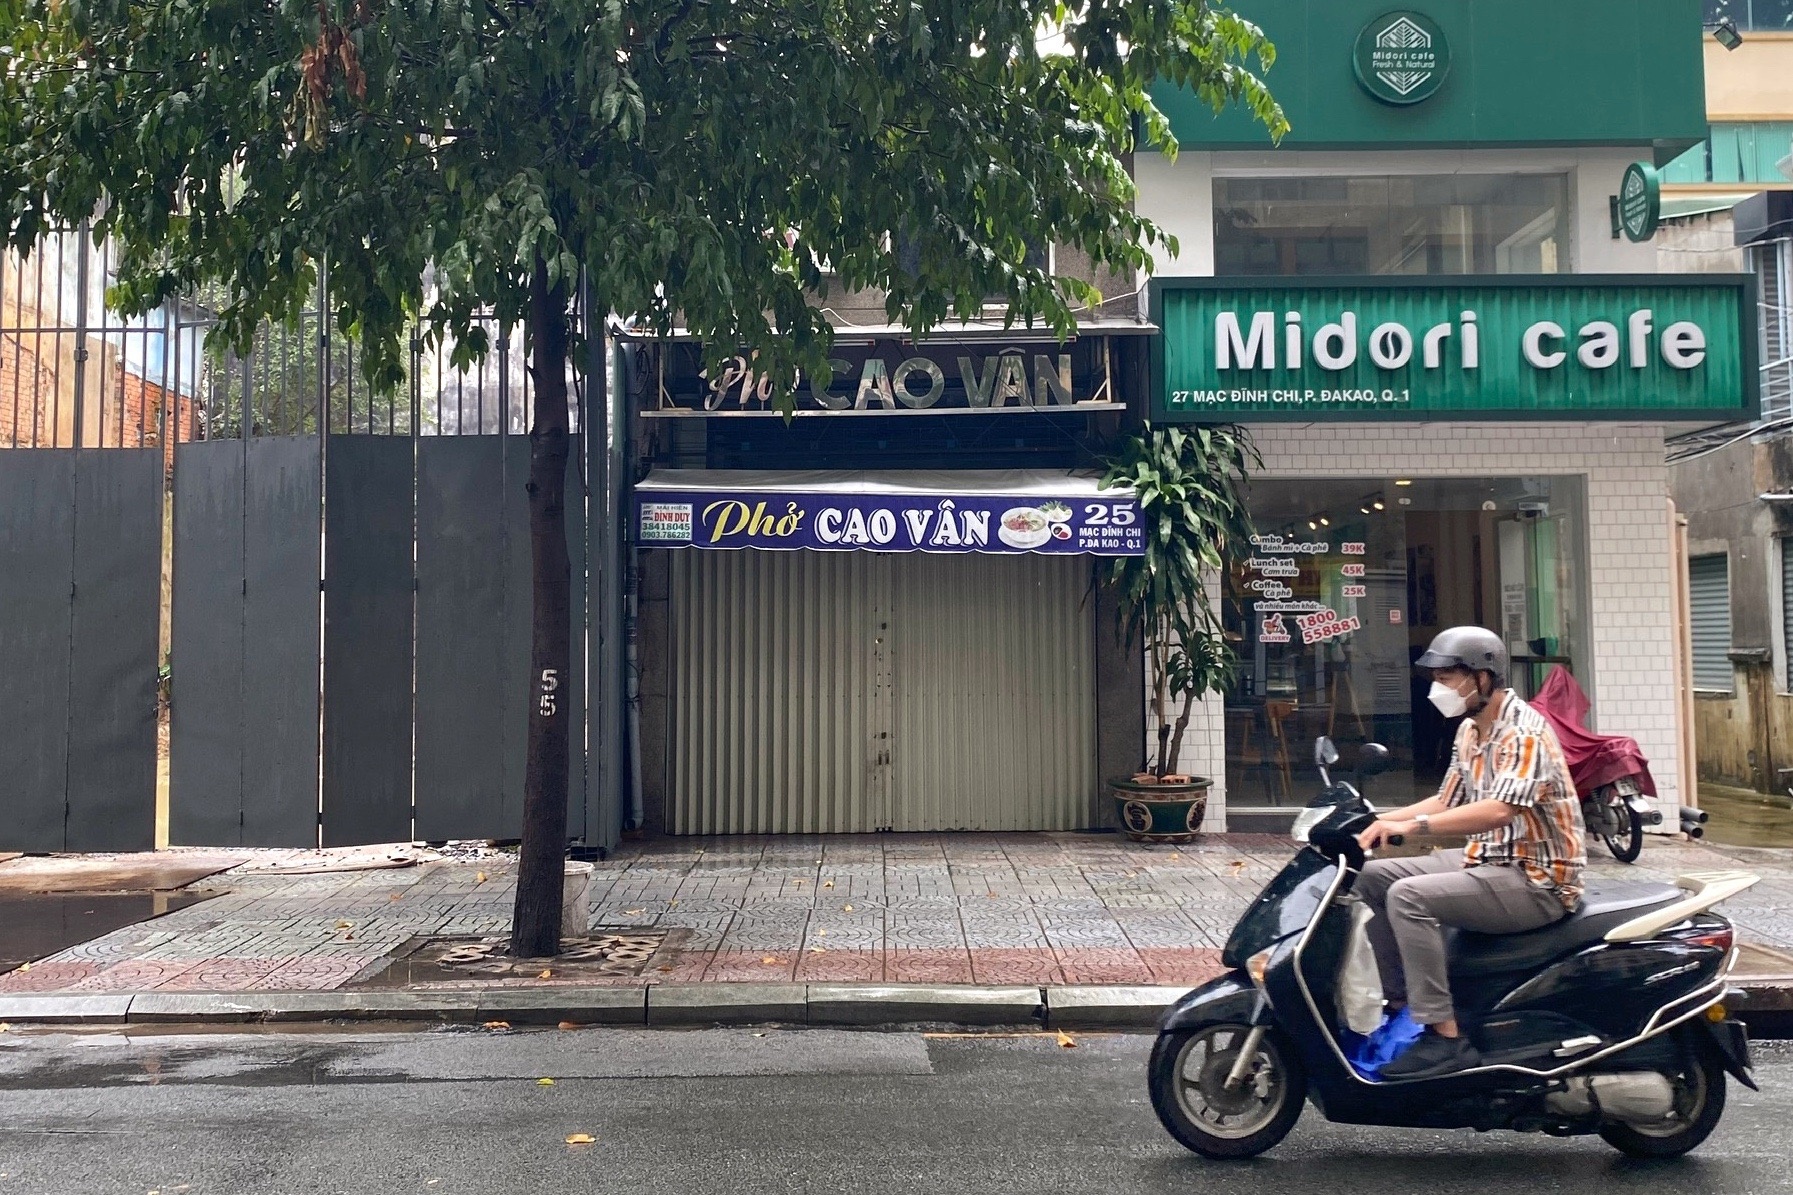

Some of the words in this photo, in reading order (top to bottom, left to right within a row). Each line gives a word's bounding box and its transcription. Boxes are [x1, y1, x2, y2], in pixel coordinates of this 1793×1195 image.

[1372, 51, 1407, 60] Midori
[1411, 51, 1435, 60] cafe
[1372, 60, 1394, 69] Fresh
[1396, 60, 1403, 69] &
[1405, 60, 1436, 69] Natural
[1215, 310, 1478, 371] Midori
[1522, 309, 1706, 370] cafe
[810, 356, 946, 410] CAO
[957, 347, 1073, 408] VÂN
[1172, 391, 1189, 403] 27
[1193, 390, 1227, 406] MẠC
[1231, 387, 1268, 402] ĐĨNH
[674, 512, 690, 522] DUY
[1084, 501, 1136, 526] 25
[642, 522, 691, 531] 38418045
[702, 500, 806, 543] Phở
[814, 507, 898, 545] CAO
[902, 499, 992, 547] VÂN
[641, 531, 691, 539] 0903.786282
[1079, 527, 1100, 538] MẠC
[1125, 527, 1141, 537] CHI
[1101, 539, 1120, 548] KAO
[1126, 539, 1141, 549] Q.1
[1342, 543, 1364, 553] 39K
[1251, 559, 1279, 567] Lunch
[1342, 564, 1364, 575] 45K
[1253, 580, 1283, 589] Coffee
[1343, 586, 1365, 596] 25K
[1298, 610, 1335, 629] 1800
[1303, 617, 1360, 642] 558881
